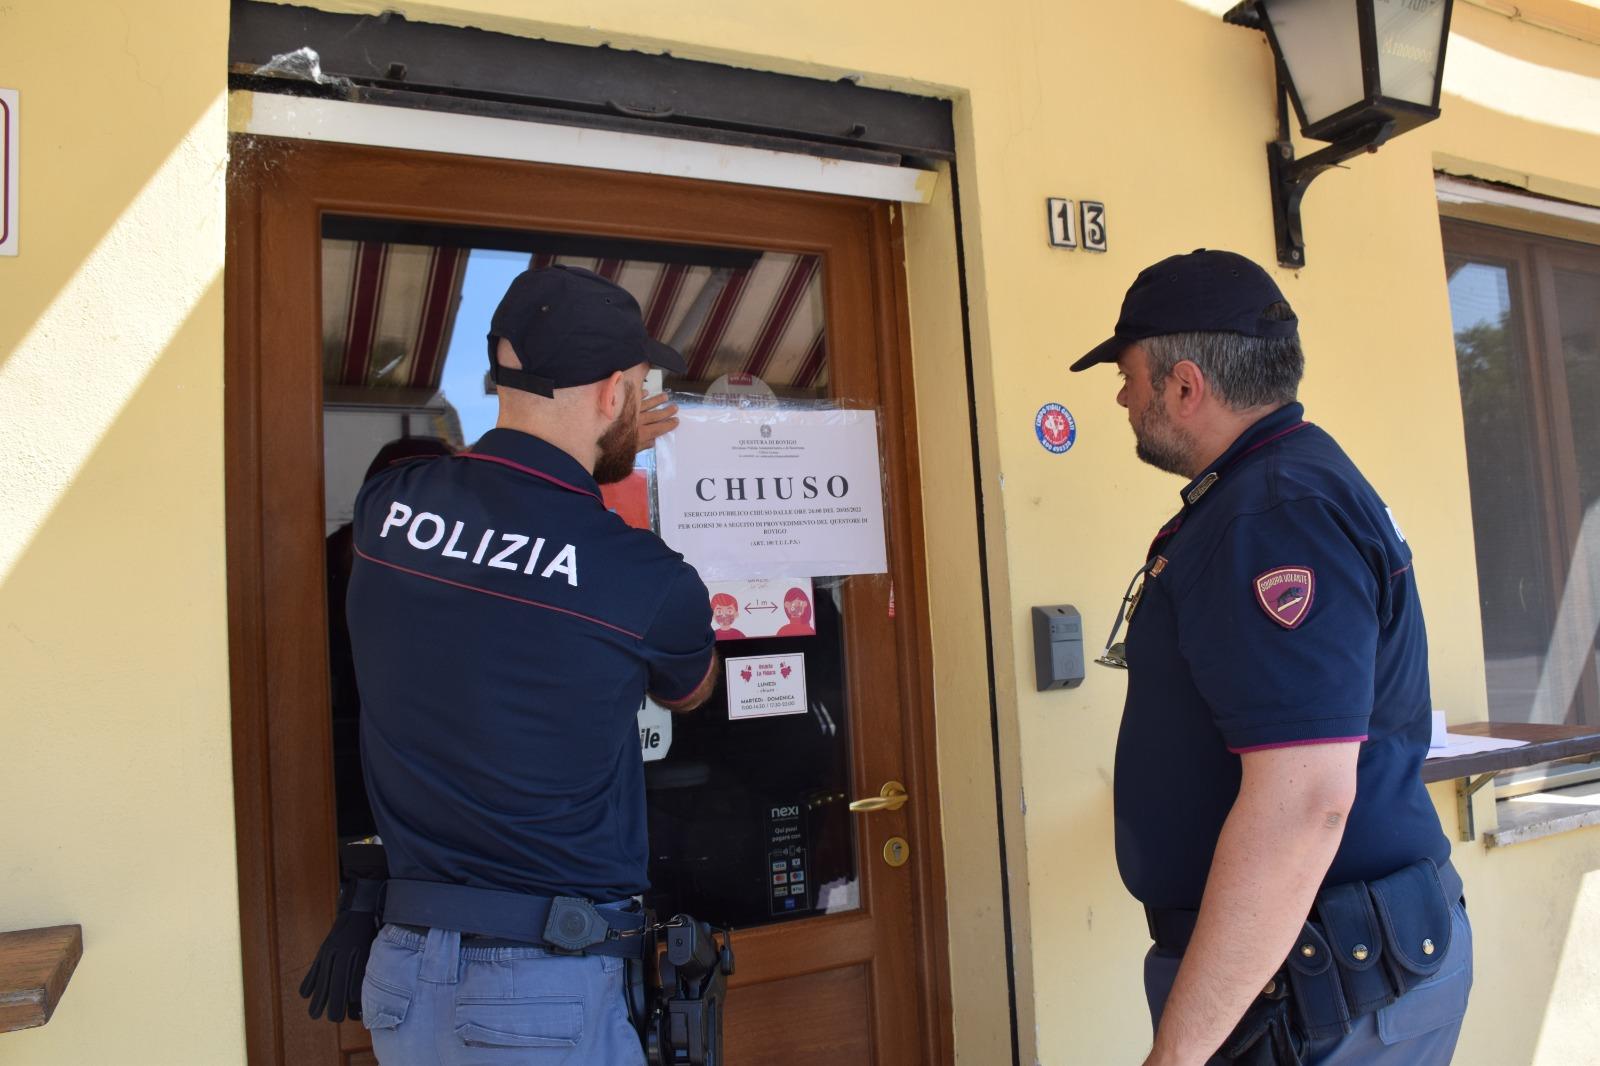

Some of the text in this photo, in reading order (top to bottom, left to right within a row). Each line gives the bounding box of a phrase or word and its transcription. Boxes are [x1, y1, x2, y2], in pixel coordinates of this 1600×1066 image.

[1057, 203, 1106, 245] 13
[695, 474, 850, 502] CHIUSO
[379, 501, 578, 587] POLIZIA
[1260, 573, 1308, 592] SQUADRA VOLANTE
[771, 805, 799, 818] nexi
